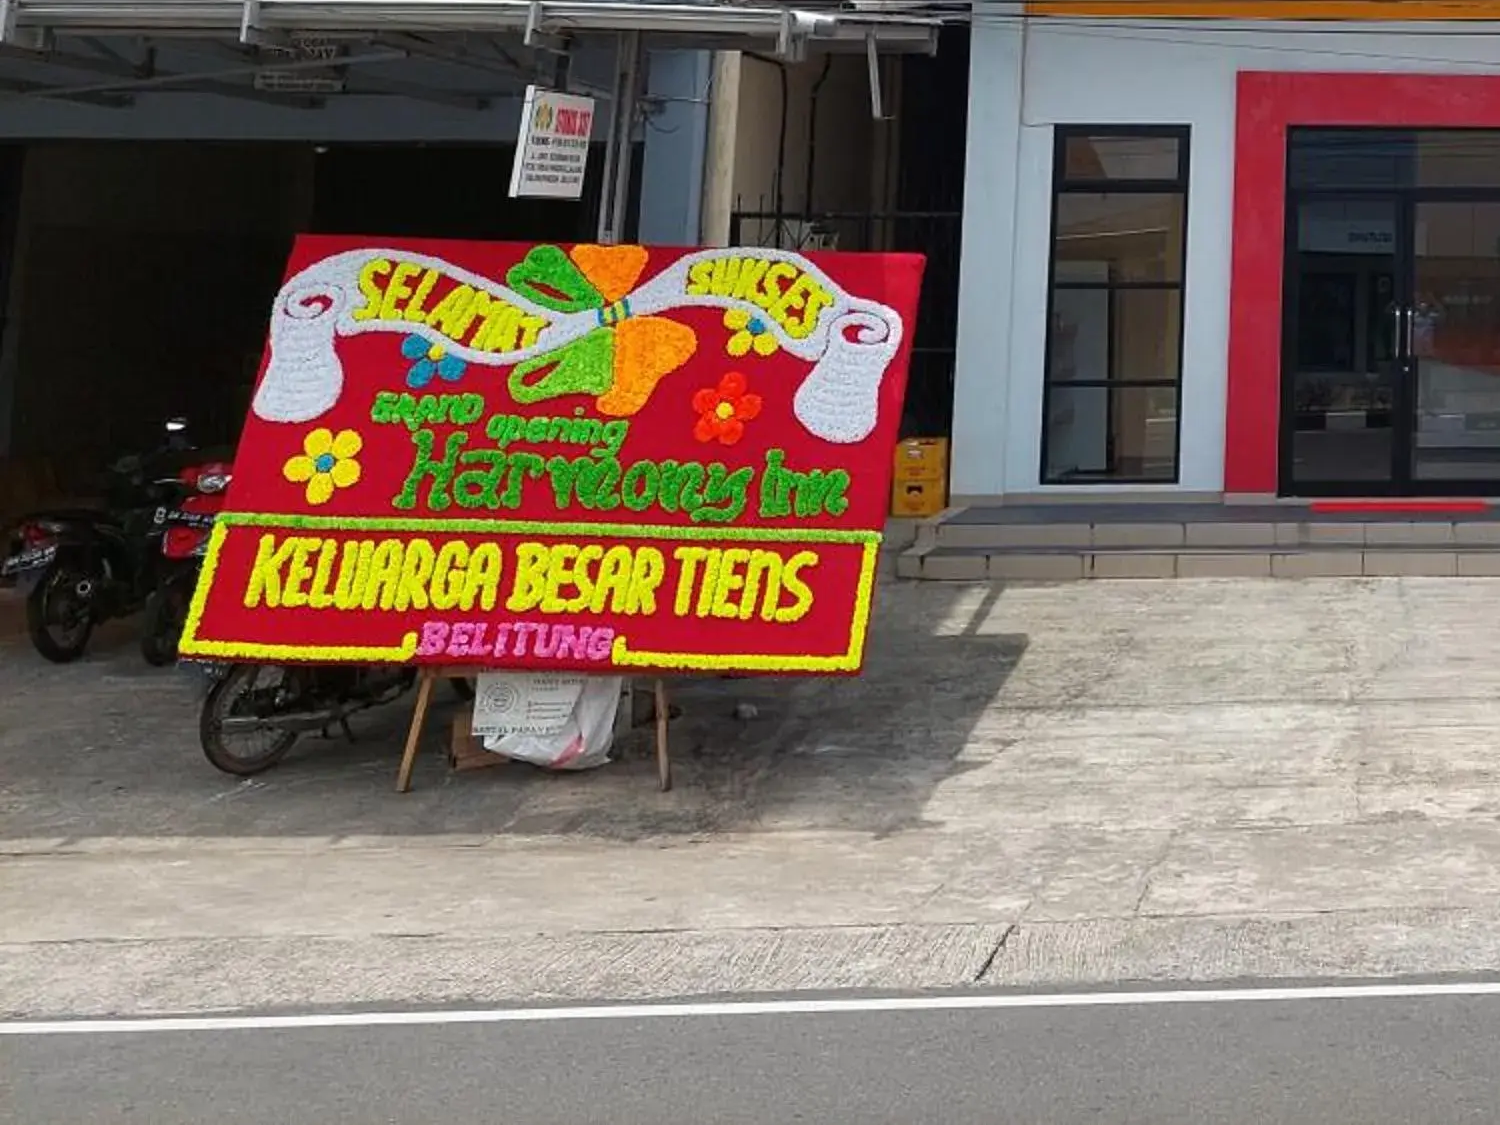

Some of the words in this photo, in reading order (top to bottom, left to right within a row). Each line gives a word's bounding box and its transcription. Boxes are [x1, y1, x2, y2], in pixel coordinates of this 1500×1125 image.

[352, 257, 547, 352] SELAMAT
[687, 256, 833, 339] SUKSES
[392, 429, 754, 522] Harmony
[243, 533, 502, 612] KELUARGA
[505, 542, 664, 615] BESAR
[674, 546, 819, 622] TIENS
[416, 621, 614, 660] BELITUNG
